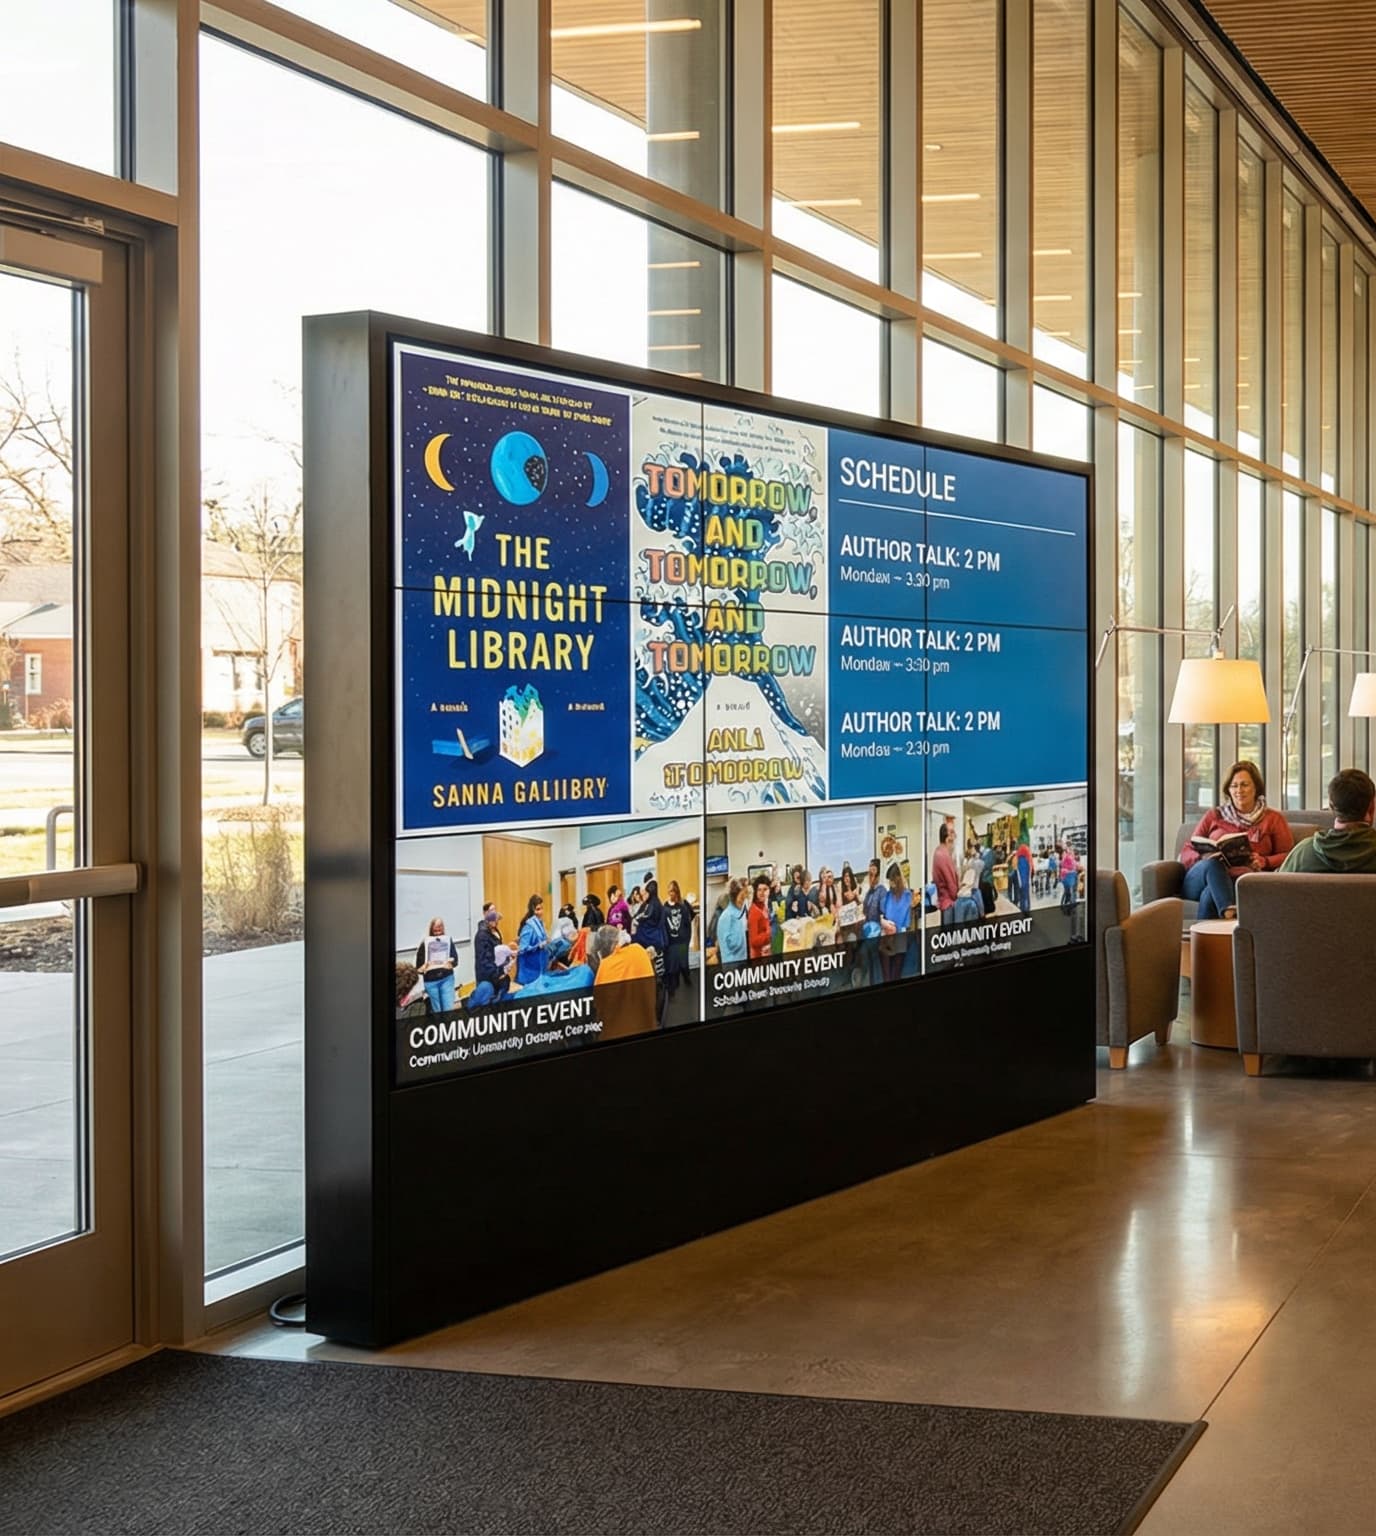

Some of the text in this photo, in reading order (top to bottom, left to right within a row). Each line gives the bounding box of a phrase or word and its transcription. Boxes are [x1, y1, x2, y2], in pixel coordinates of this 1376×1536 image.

[642, 462, 818, 523] TOMORROW,
[840, 457, 956, 502] SCHEDULE
[705, 514, 764, 550] AND
[495, 533, 551, 570] THE
[840, 534, 1000, 572] AUTHOR TALK: 2 PM
[643, 548, 818, 601] TOMORROW,
[933, 576, 950, 592] pm
[433, 575, 608, 624] MIDNIGHT
[704, 598, 766, 634] AND
[448, 628, 595, 671] LIBRARY
[841, 625, 1001, 653] AUTHOR TALK: 2 PM
[647, 640, 817, 677] TOMORROW
[933, 659, 950, 675] pm
[841, 710, 1001, 734] AUTHOR TALK: 2 PM
[933, 742, 950, 758] pm
[432, 782, 504, 808] SANNA
[930, 917, 1033, 950] COMMUNITY EVENT
[713, 951, 846, 991] COMMUNITY EVENT
[409, 1007, 533, 1049] COMMUNITY
[536, 996, 594, 1025] EVENT
